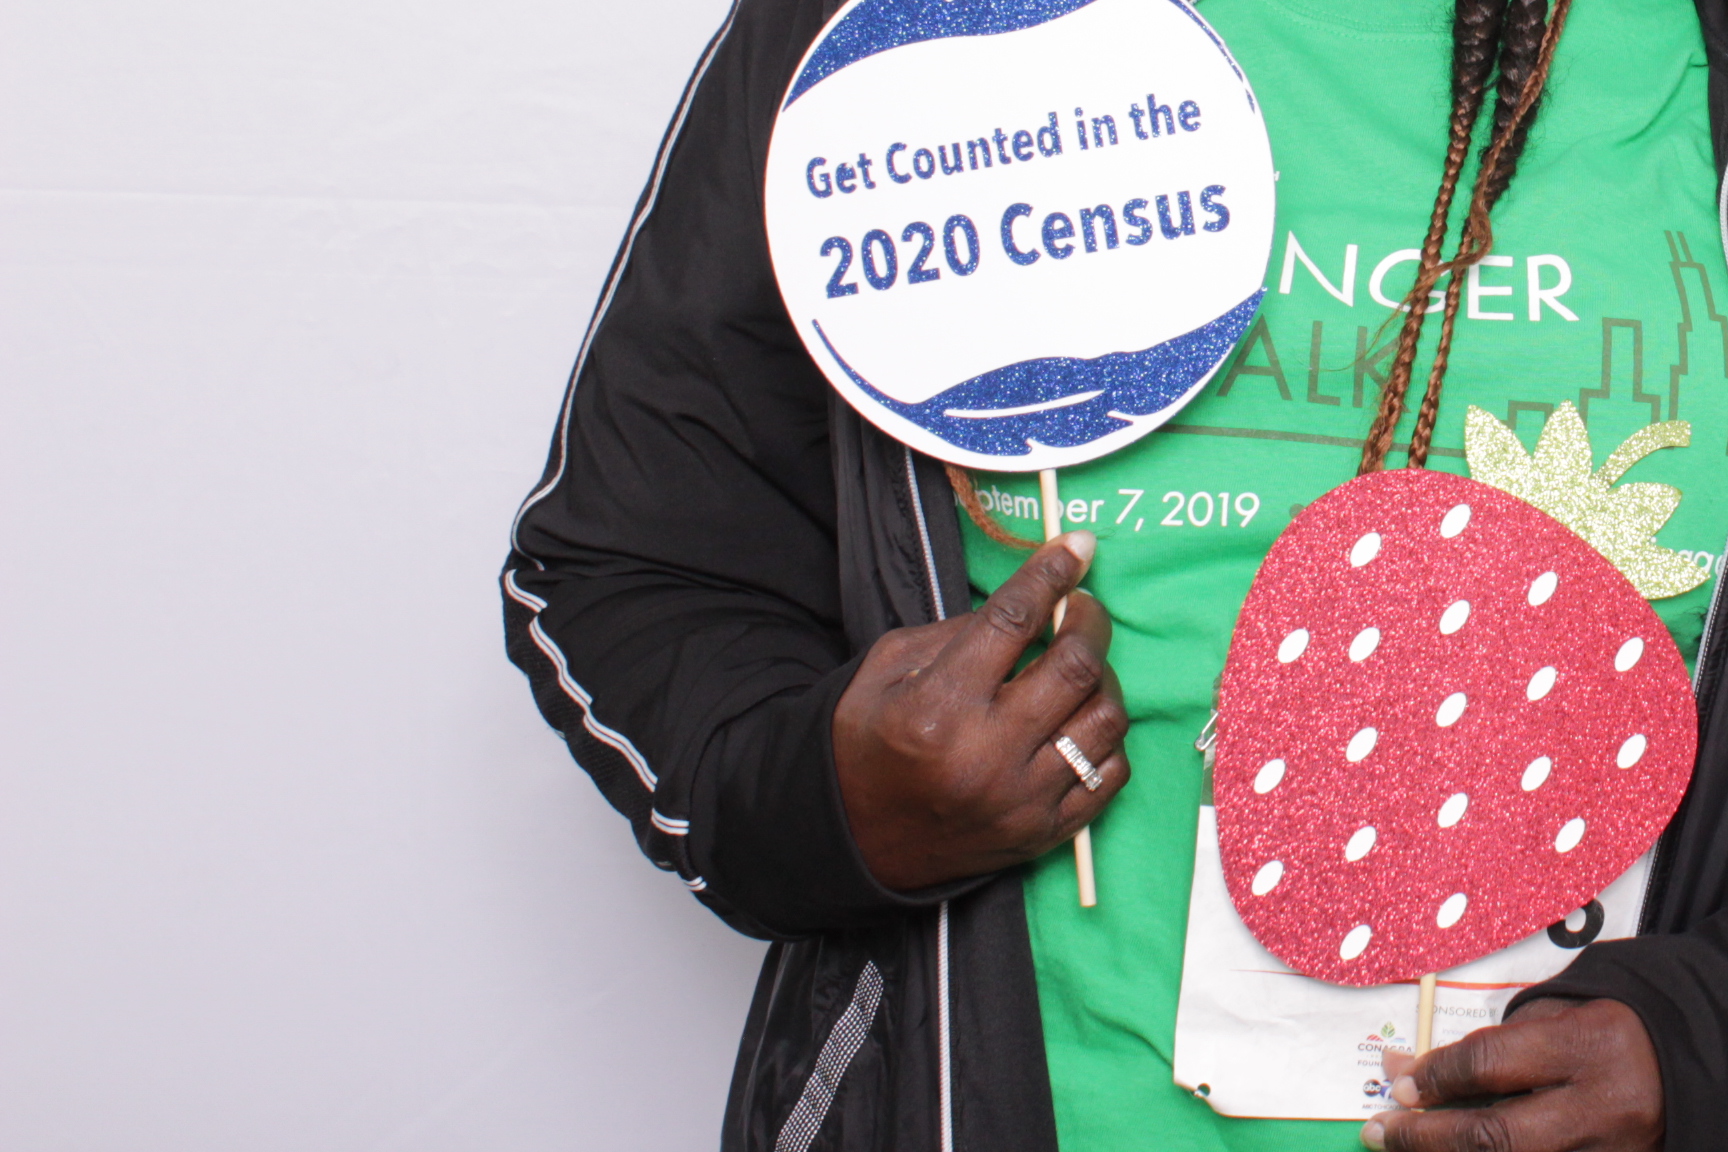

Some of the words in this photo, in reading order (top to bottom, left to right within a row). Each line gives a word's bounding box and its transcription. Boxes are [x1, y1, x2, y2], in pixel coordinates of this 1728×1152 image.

[806, 153, 876, 198] Get
[886, 112, 1063, 184] Counted
[1074, 107, 1119, 151] in
[1129, 93, 1202, 141] the
[819, 214, 980, 299] 2020
[1000, 184, 1231, 266] Census
[1278, 230, 1580, 322] NGER
[1216, 313, 1411, 413] ALK
[954, 485, 1105, 524] ptemer
[1115, 489, 1145, 532] 7,
[1160, 491, 1261, 528] 2019
